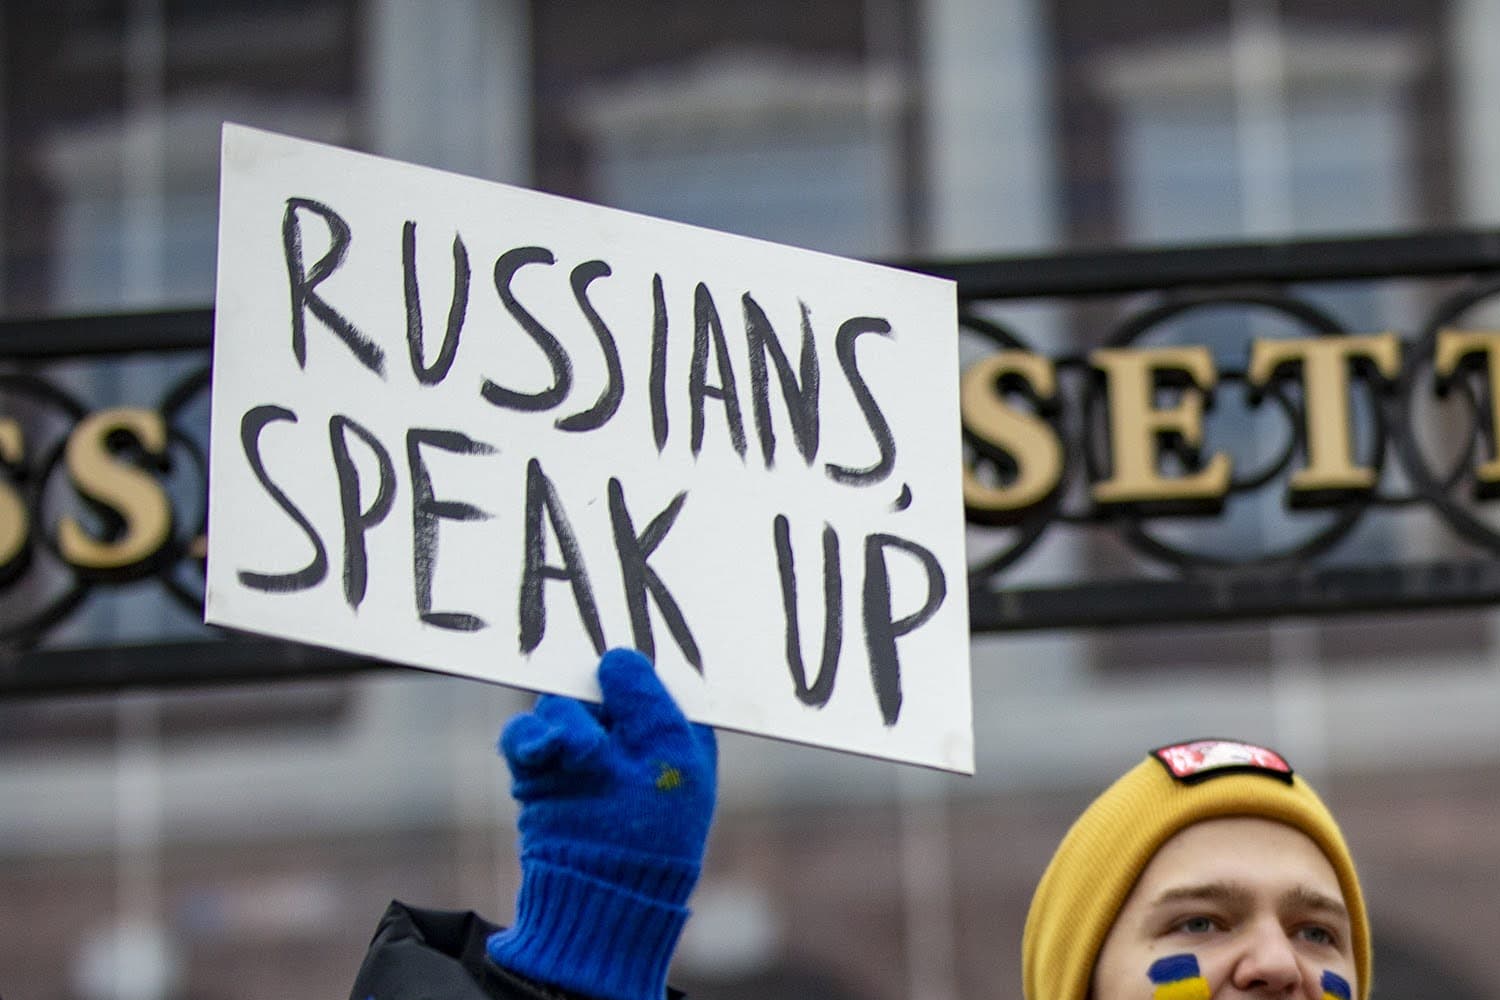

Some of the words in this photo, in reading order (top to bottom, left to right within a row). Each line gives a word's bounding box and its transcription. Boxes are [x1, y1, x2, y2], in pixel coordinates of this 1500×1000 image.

[282, 196, 912, 512] RUSSIANS,
[237, 405, 706, 680] SPEAK
[773, 513, 947, 727] UP
